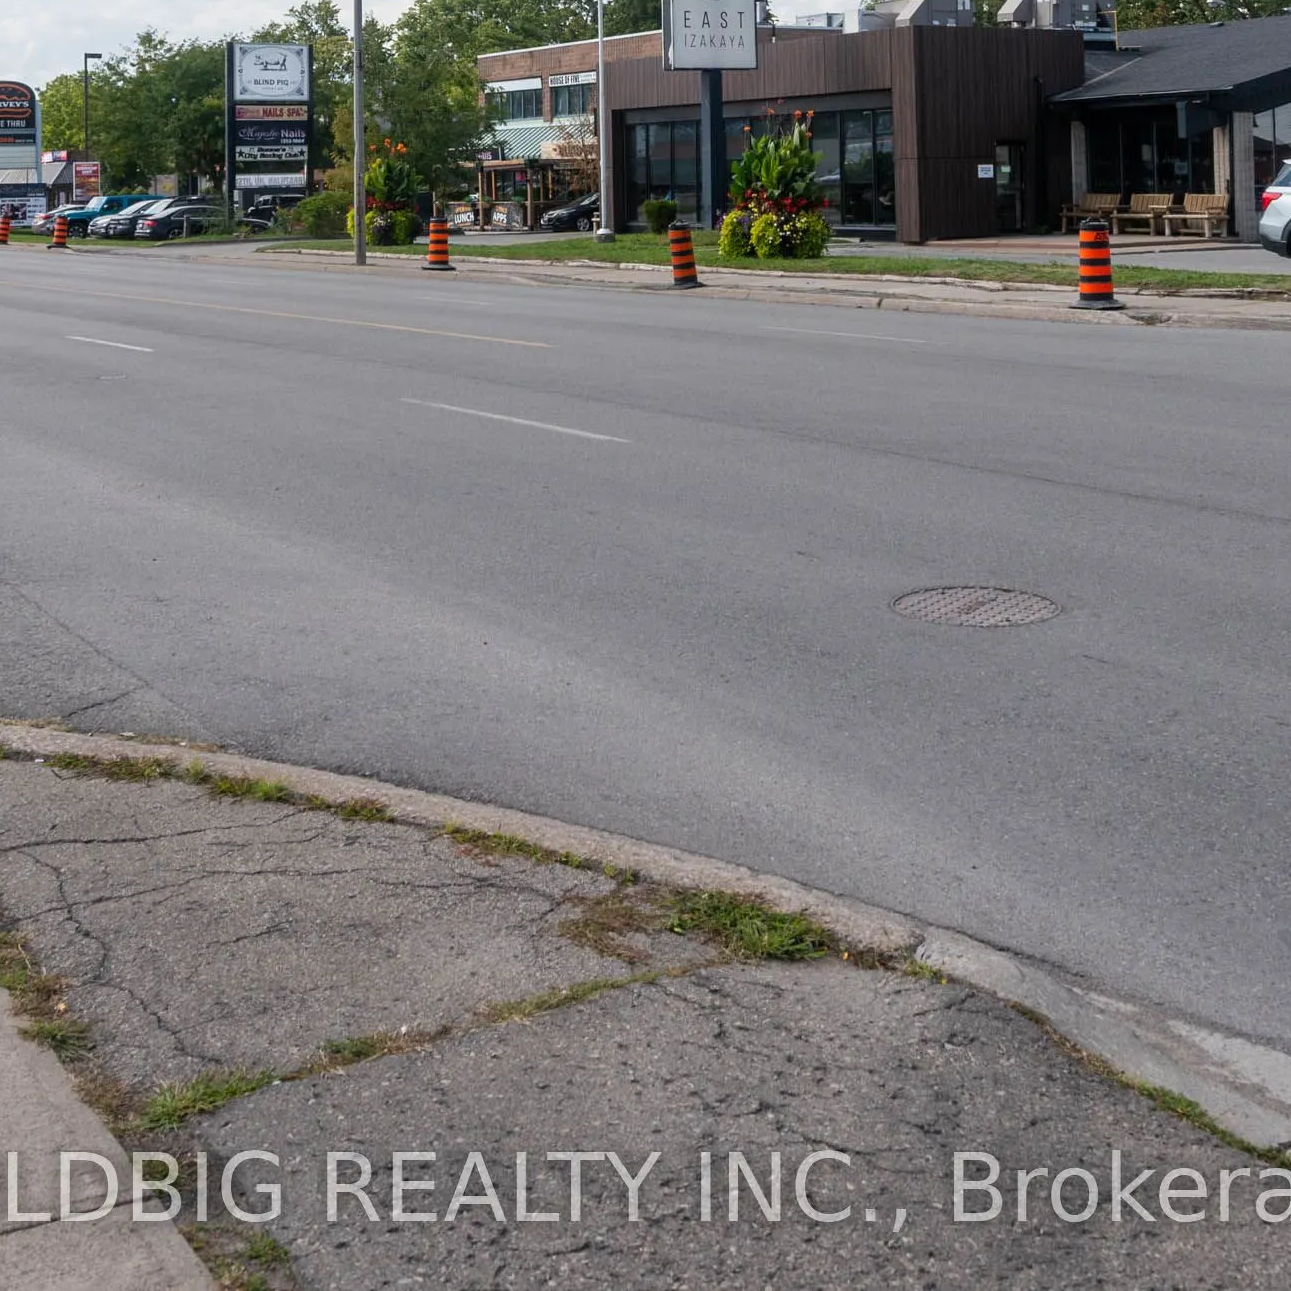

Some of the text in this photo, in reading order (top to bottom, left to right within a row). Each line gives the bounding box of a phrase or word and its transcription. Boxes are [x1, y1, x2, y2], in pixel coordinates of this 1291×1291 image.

[684, 11, 745, 29] EAST
[684, 33, 745, 49] IZAKAYA
[253, 78, 276, 86] BLIND
[262, 108, 283, 118] NAILS
[5, 119, 26, 128] THRU
[280, 129, 306, 139] Nails
[454, 211, 475, 225] LUNCH
[492, 211, 508, 224] APPS
